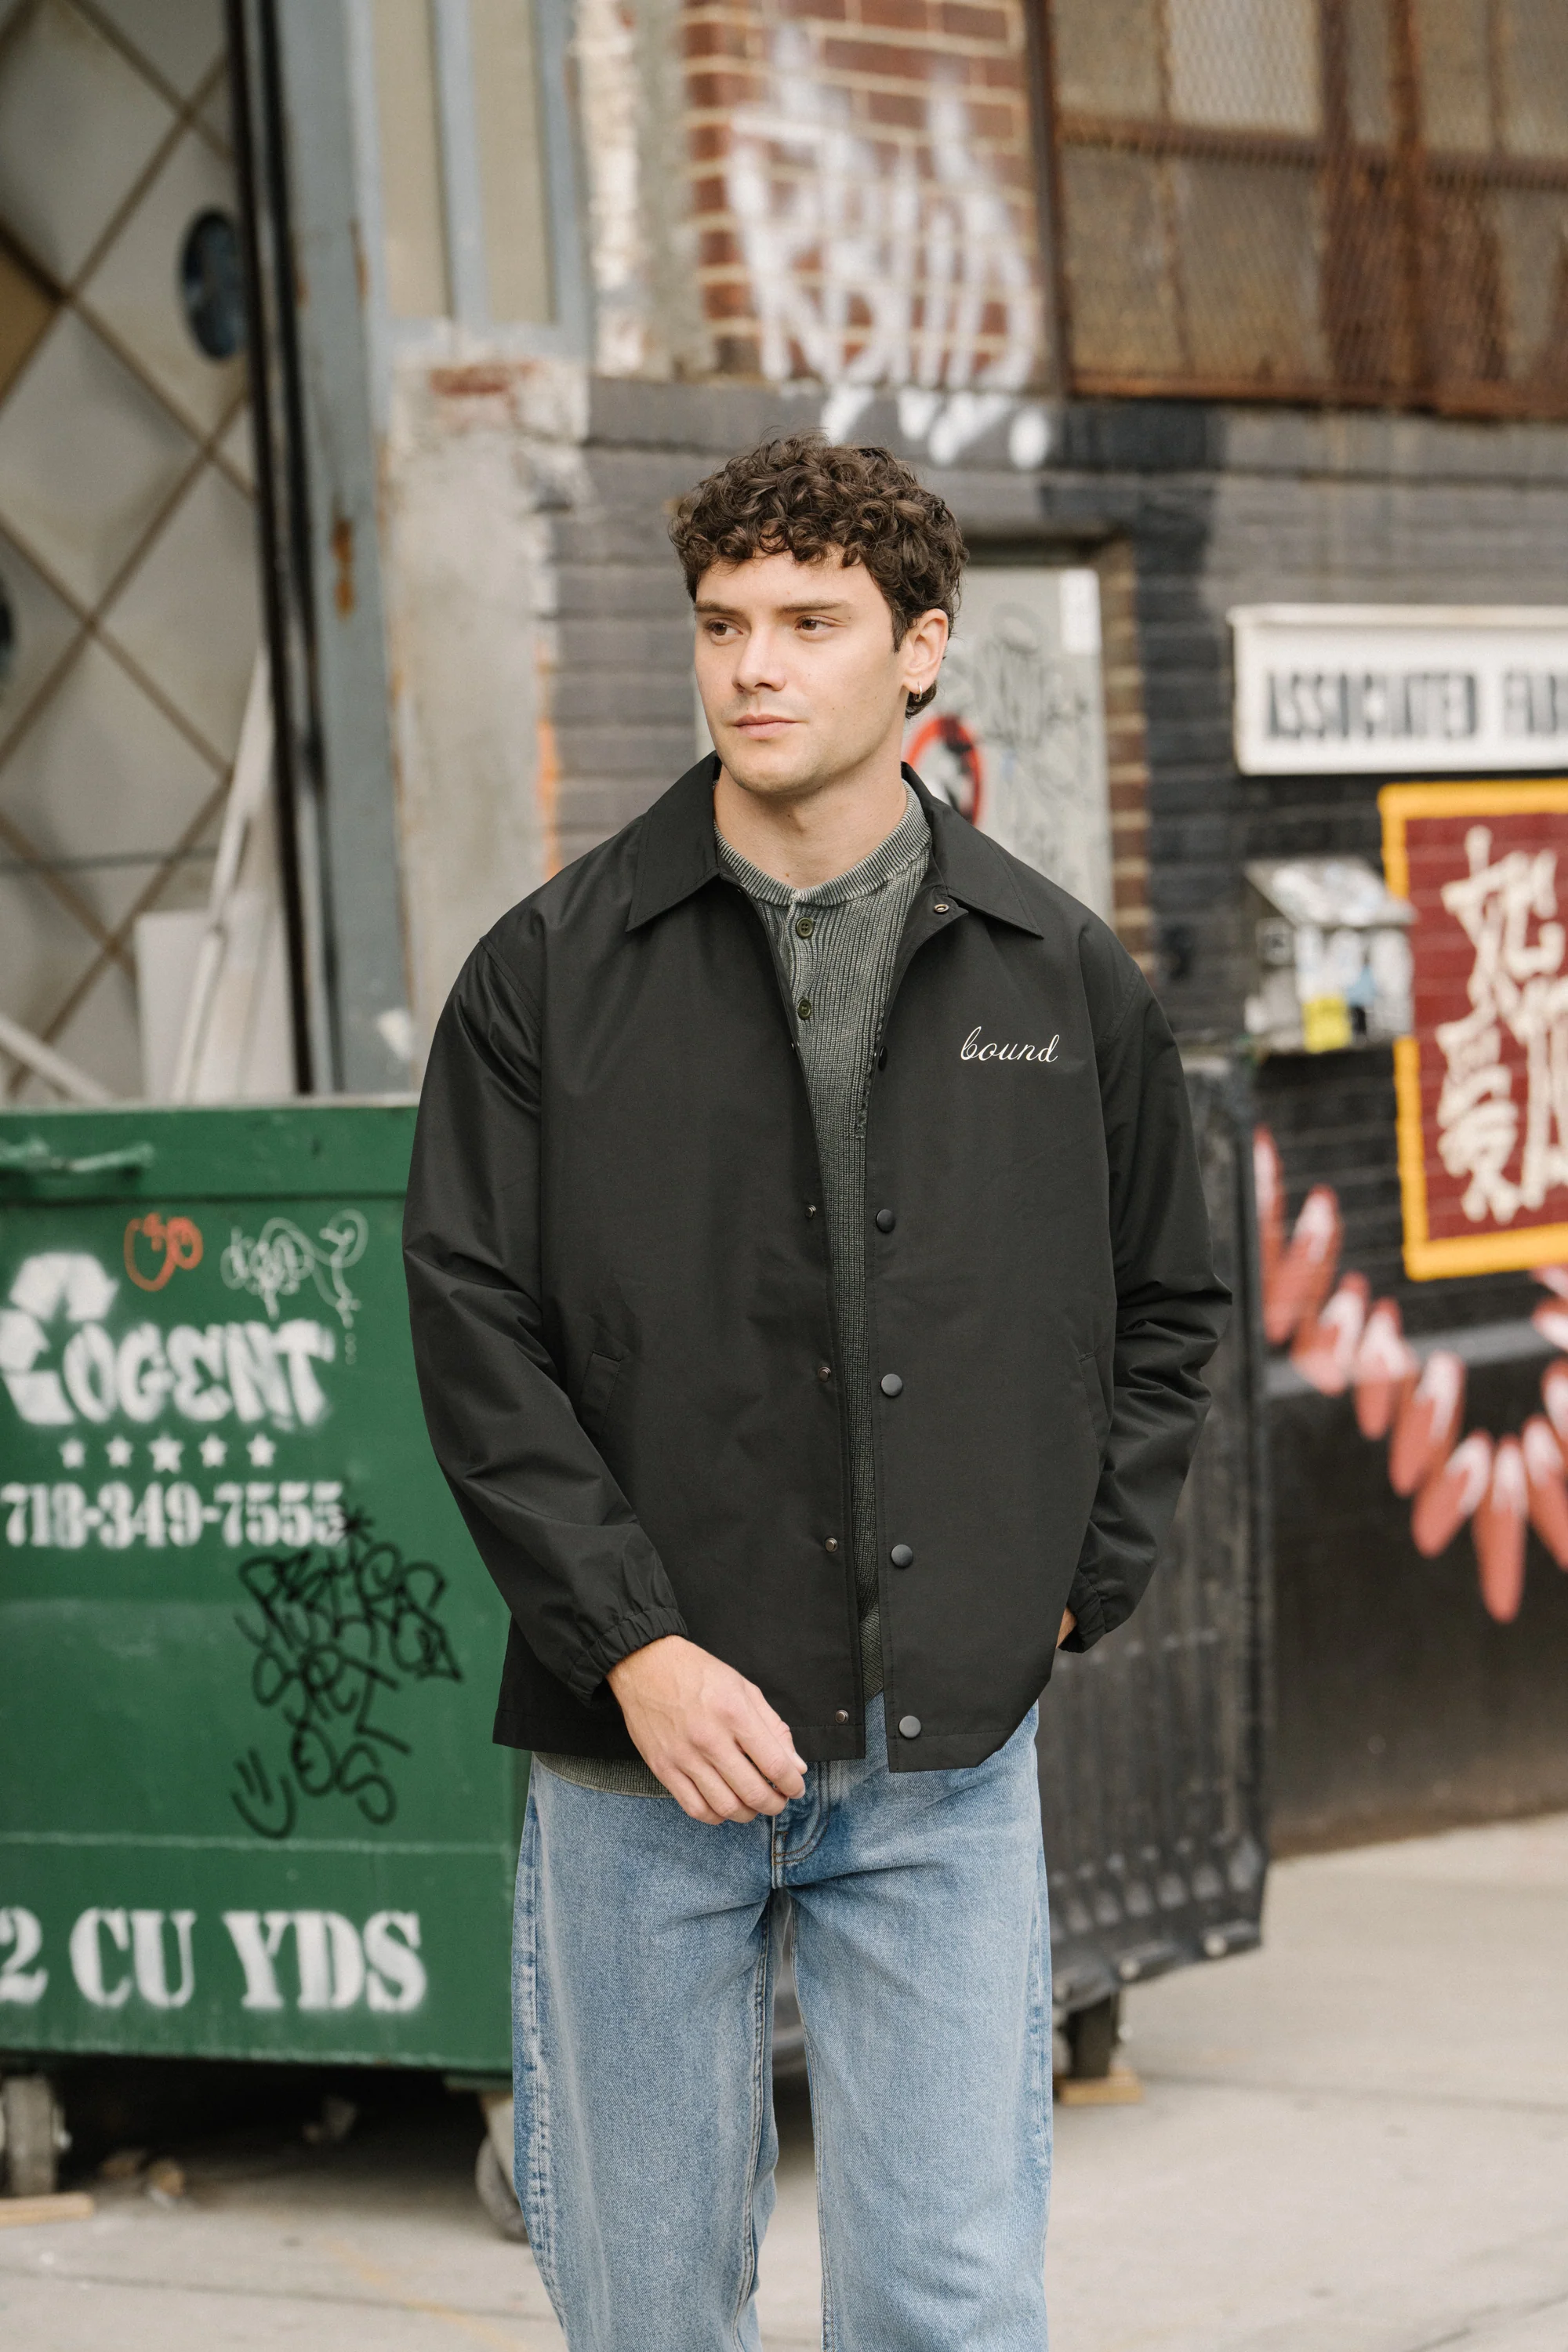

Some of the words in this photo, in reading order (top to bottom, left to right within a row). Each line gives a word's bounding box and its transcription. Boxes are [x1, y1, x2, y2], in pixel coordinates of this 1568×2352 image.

[1265, 669, 1479, 741] ASSOCIATED
[1501, 669, 1568, 739] FAB
[960, 1025, 1060, 1063] bound
[2, 1480, 347, 1549] 718-349-7555
[70, 1907, 197, 2008] CU
[223, 1910, 427, 2013] YDS
